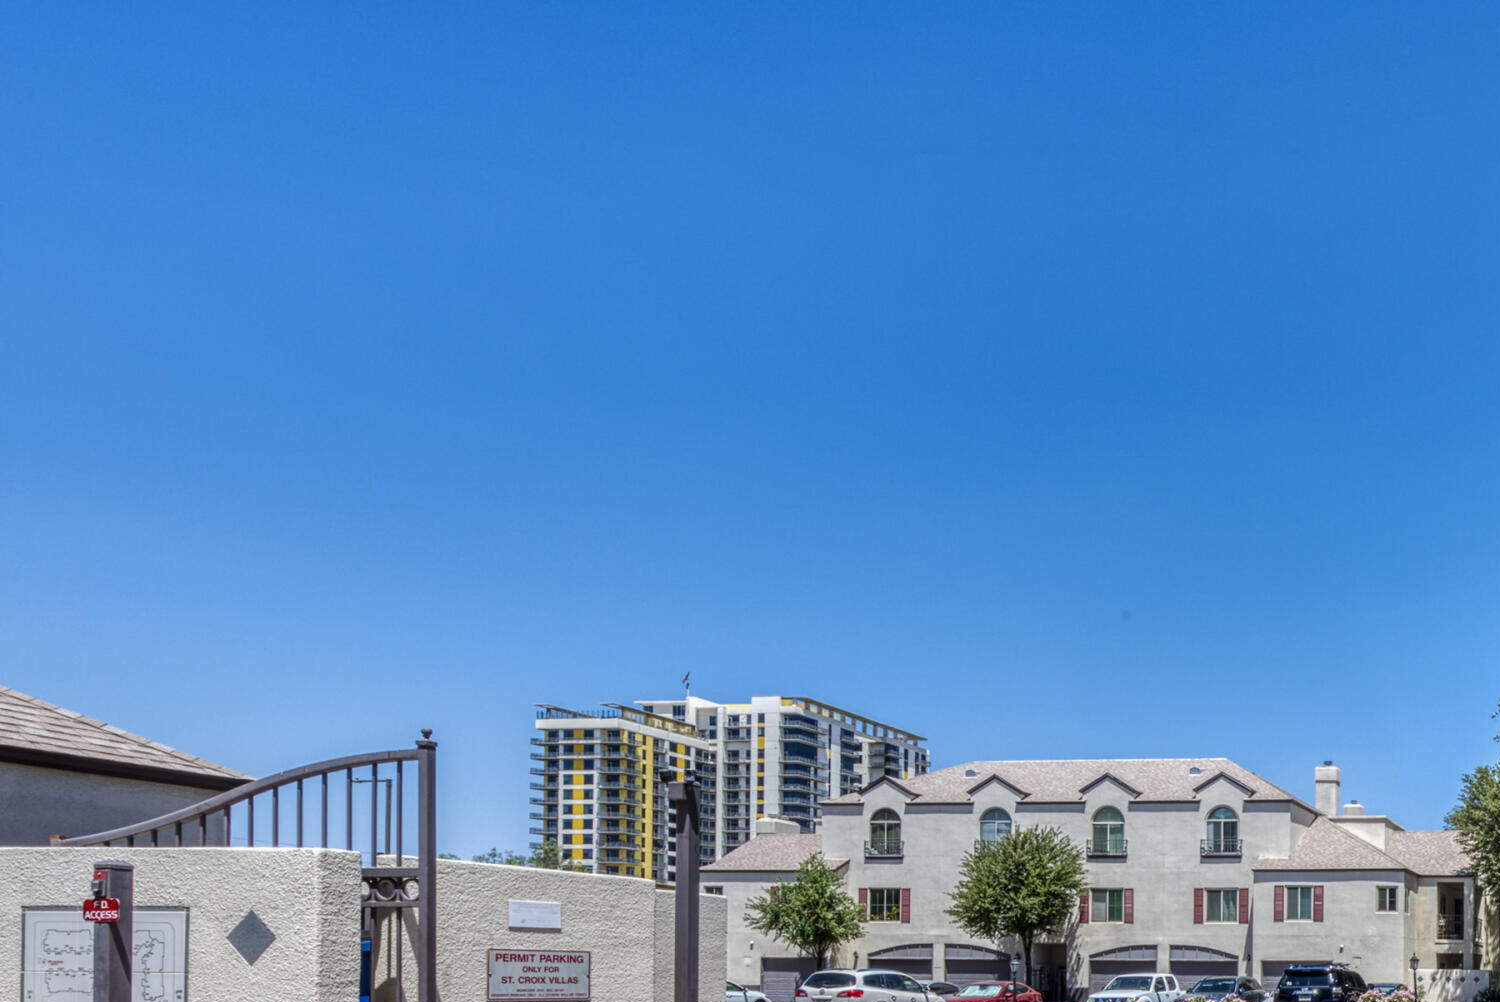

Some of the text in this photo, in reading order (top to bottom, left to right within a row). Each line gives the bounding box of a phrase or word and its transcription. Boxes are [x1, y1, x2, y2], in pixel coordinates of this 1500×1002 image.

[84, 910, 119, 920] ACCESS
[495, 953, 584, 964] PERMIT PARKING
[501, 976, 579, 985] ST. CROIX VILLAS
